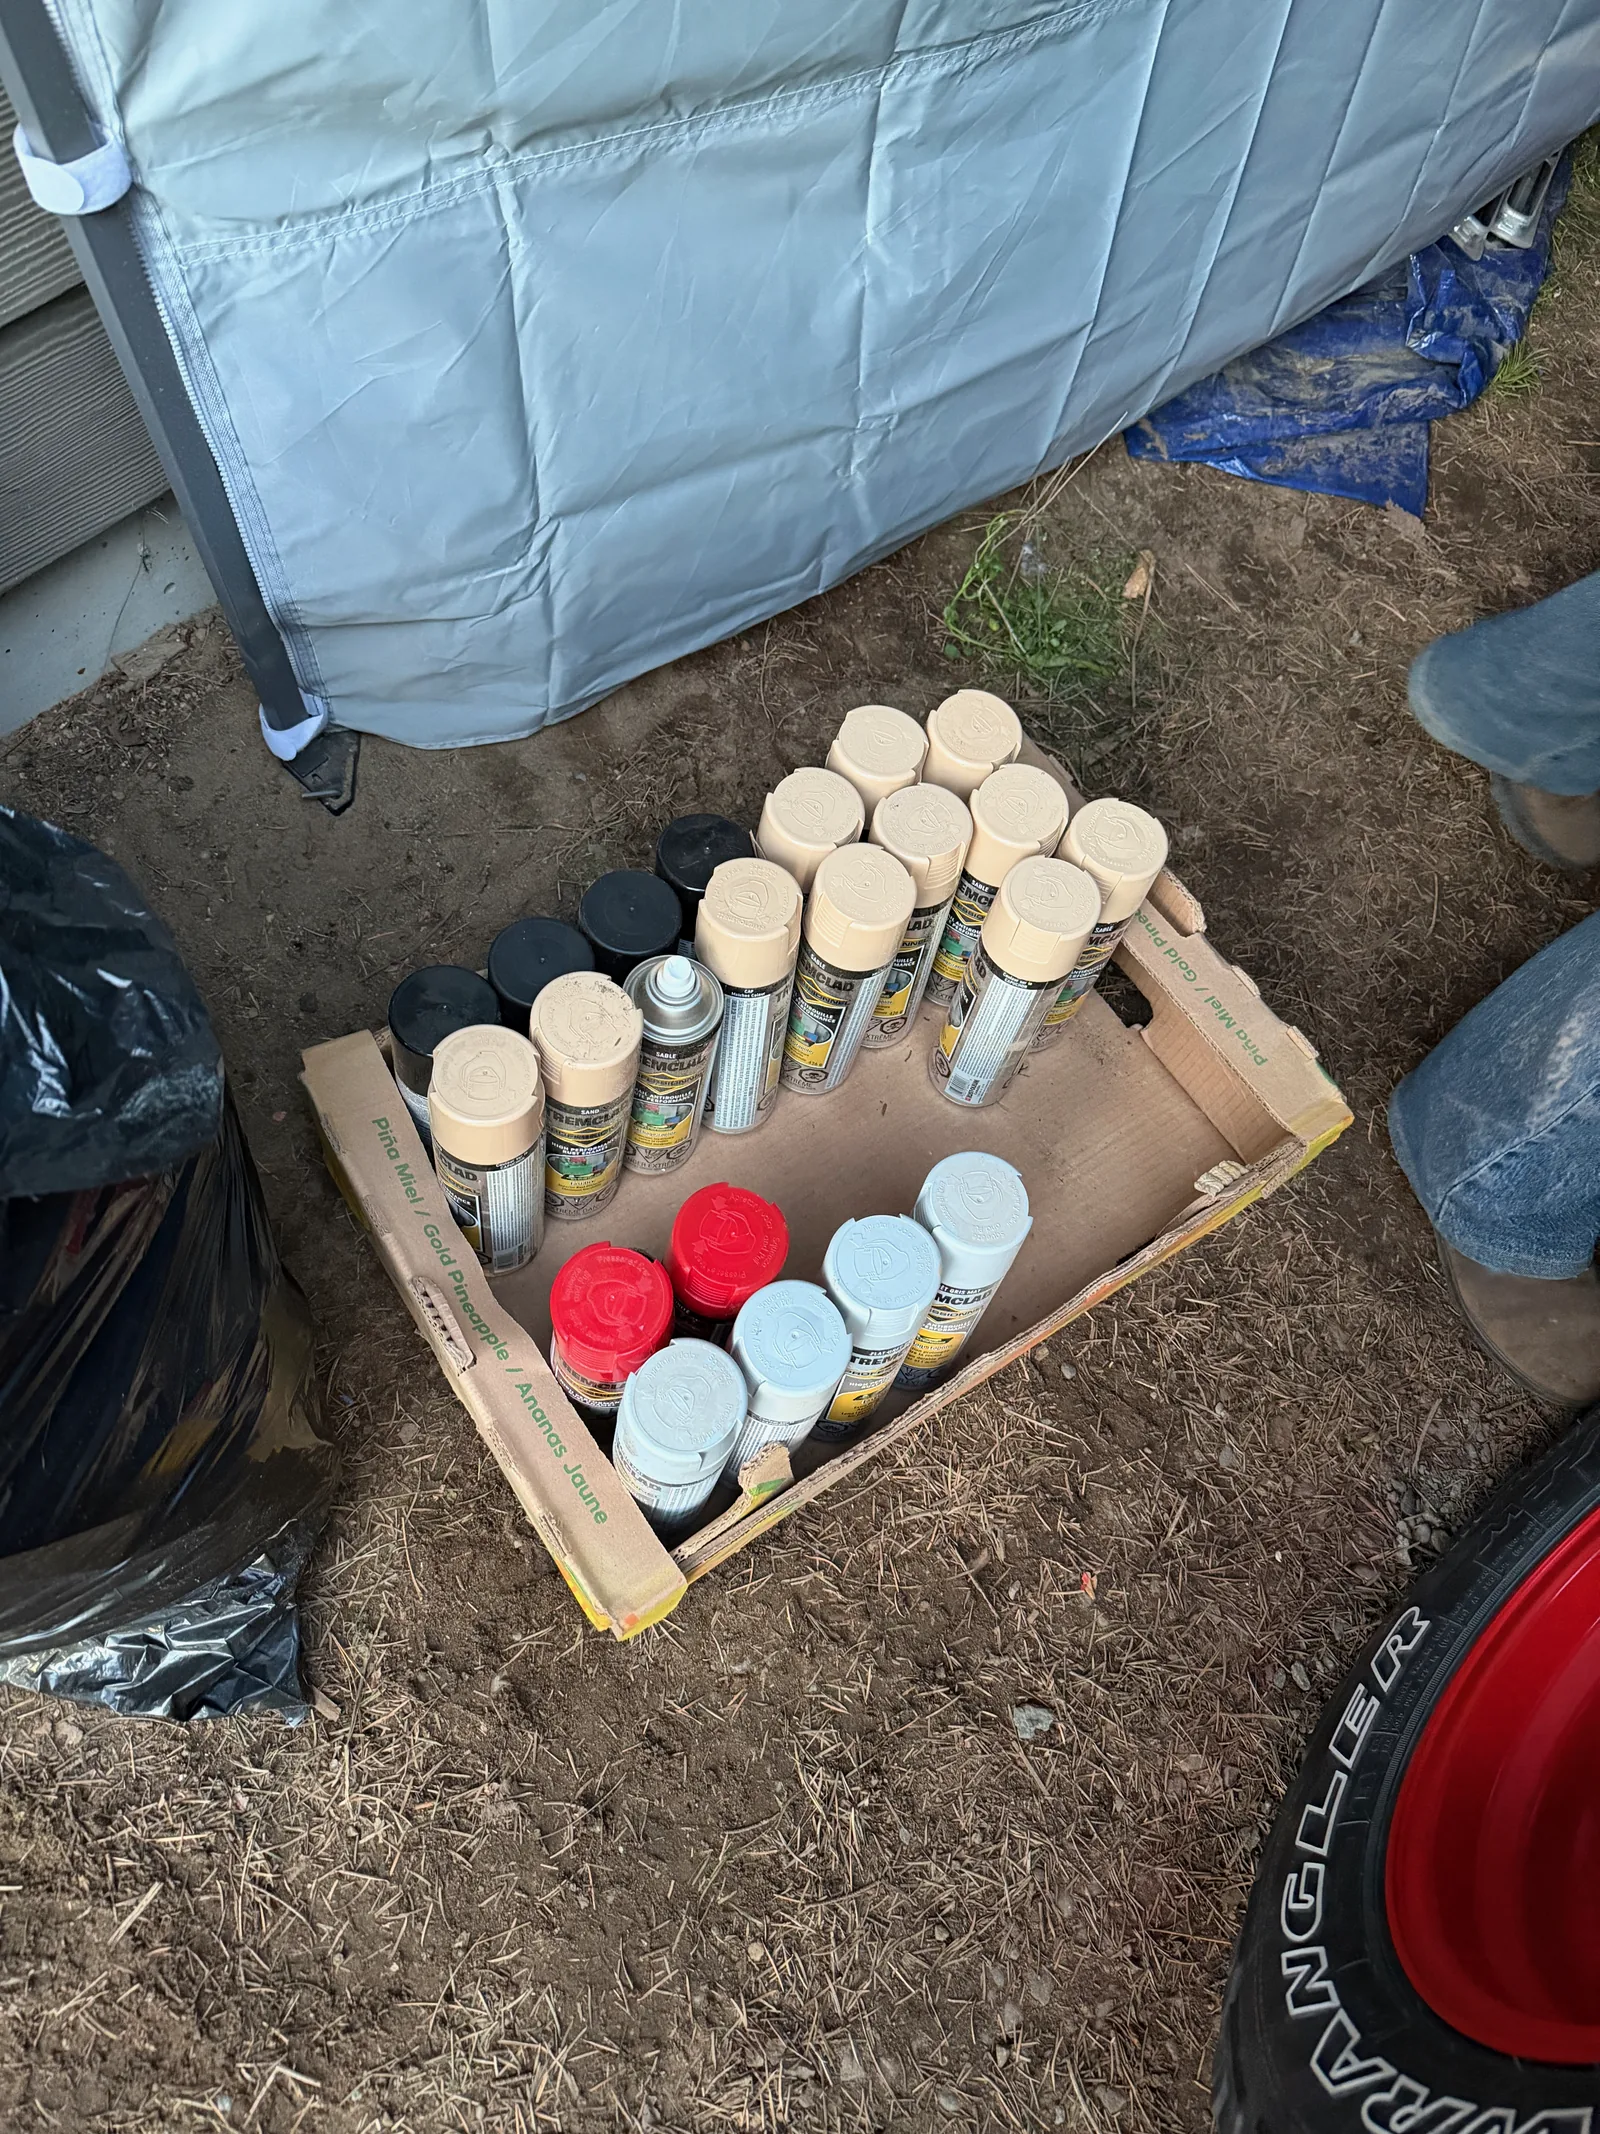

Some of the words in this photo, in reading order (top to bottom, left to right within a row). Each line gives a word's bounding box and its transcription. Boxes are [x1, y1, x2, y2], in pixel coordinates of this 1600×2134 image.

[972, 880, 989, 892] SABLE
[810, 954, 826, 969] SABLE
[1163, 948, 1197, 982] Gold
[1204, 995, 1236, 1029] Miel
[1236, 1029, 1268, 1066] Piña
[372, 1117, 400, 1160] Piña
[394, 1163, 425, 1204] Miel
[423, 1224, 457, 1266] Gold
[447, 1270, 510, 1361] Pineapple
[515, 1383, 567, 1458] Ananas
[563, 1464, 608, 1524] Jaune
